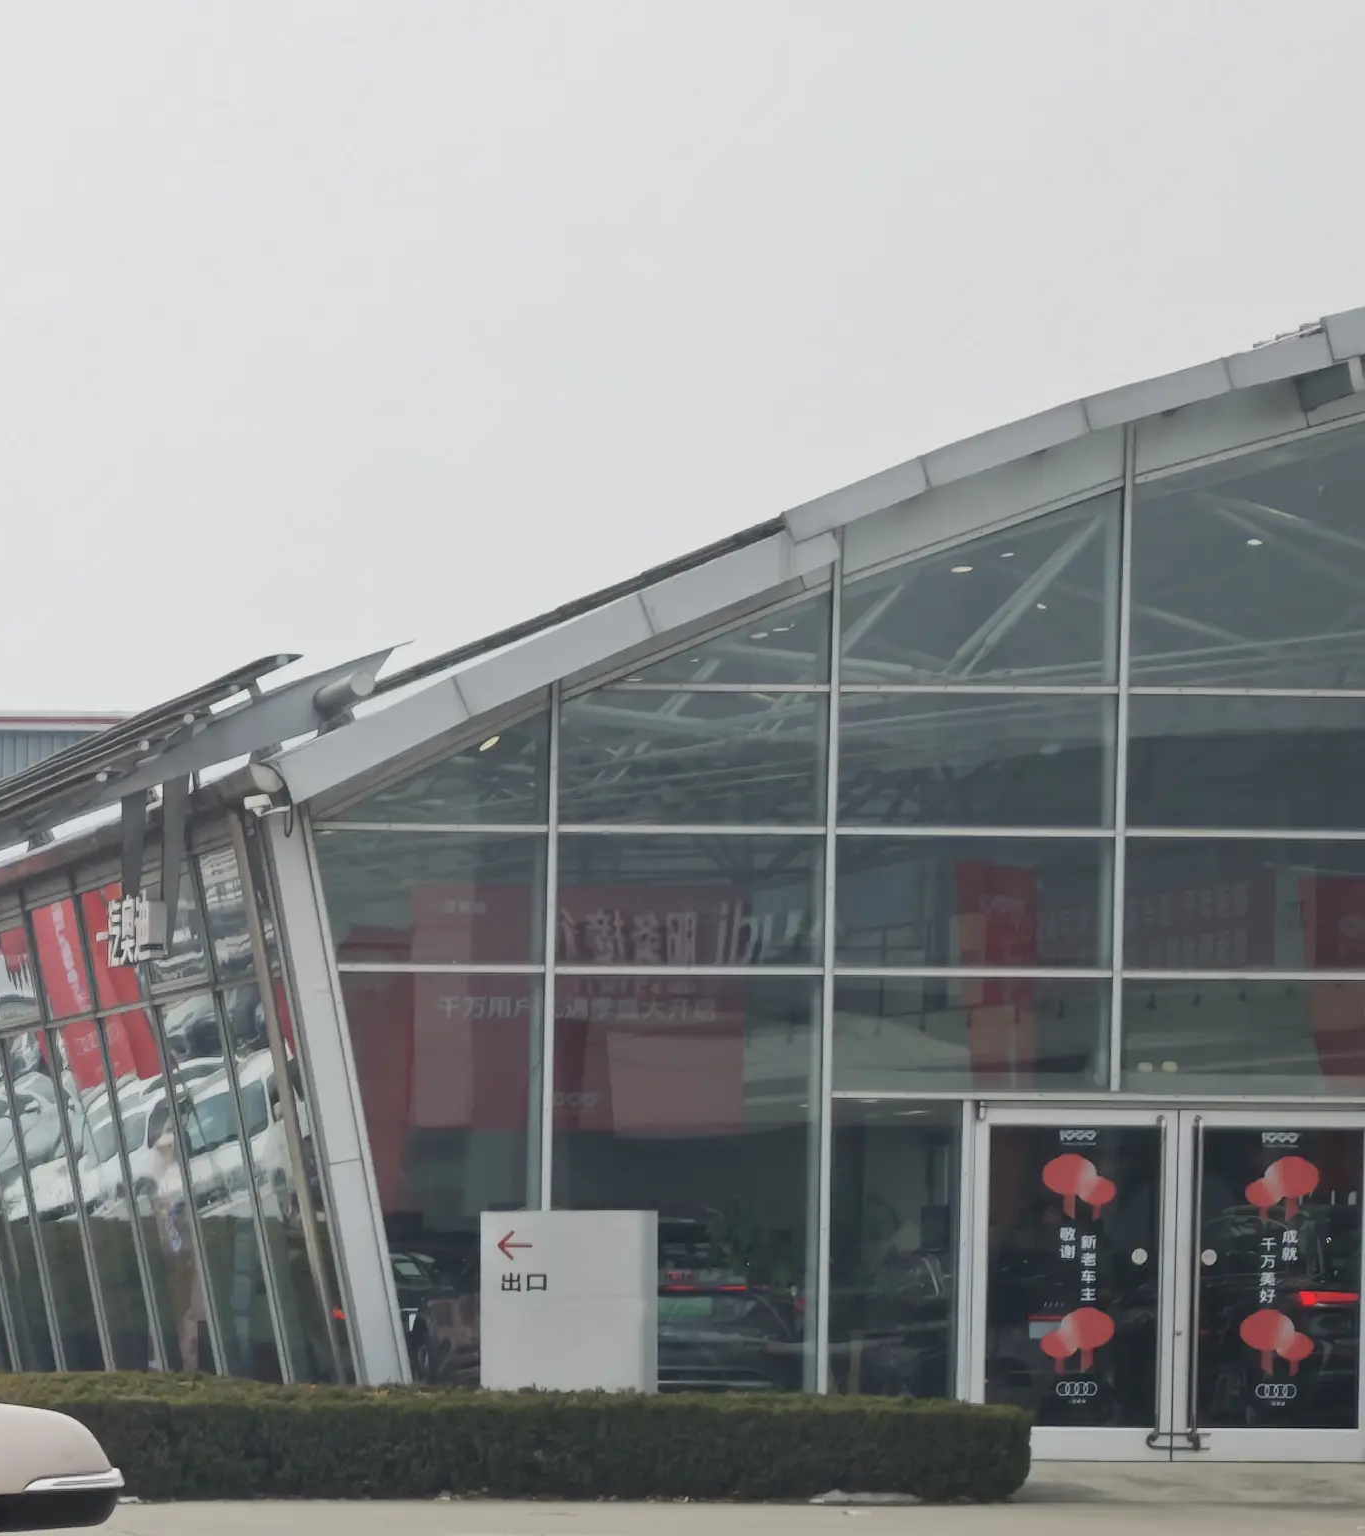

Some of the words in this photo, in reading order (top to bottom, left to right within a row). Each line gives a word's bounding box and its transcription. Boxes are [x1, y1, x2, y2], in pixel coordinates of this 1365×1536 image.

[437, 996, 719, 1021] 千万用户遇季盛大开启
[1059, 1227, 1076, 1260] 敬谢
[1281, 1229, 1299, 1262] 成就
[501, 1272, 547, 1293] 出口
[1080, 1234, 1097, 1302] 新老车主
[1259, 1237, 1277, 1304] 千万美好
